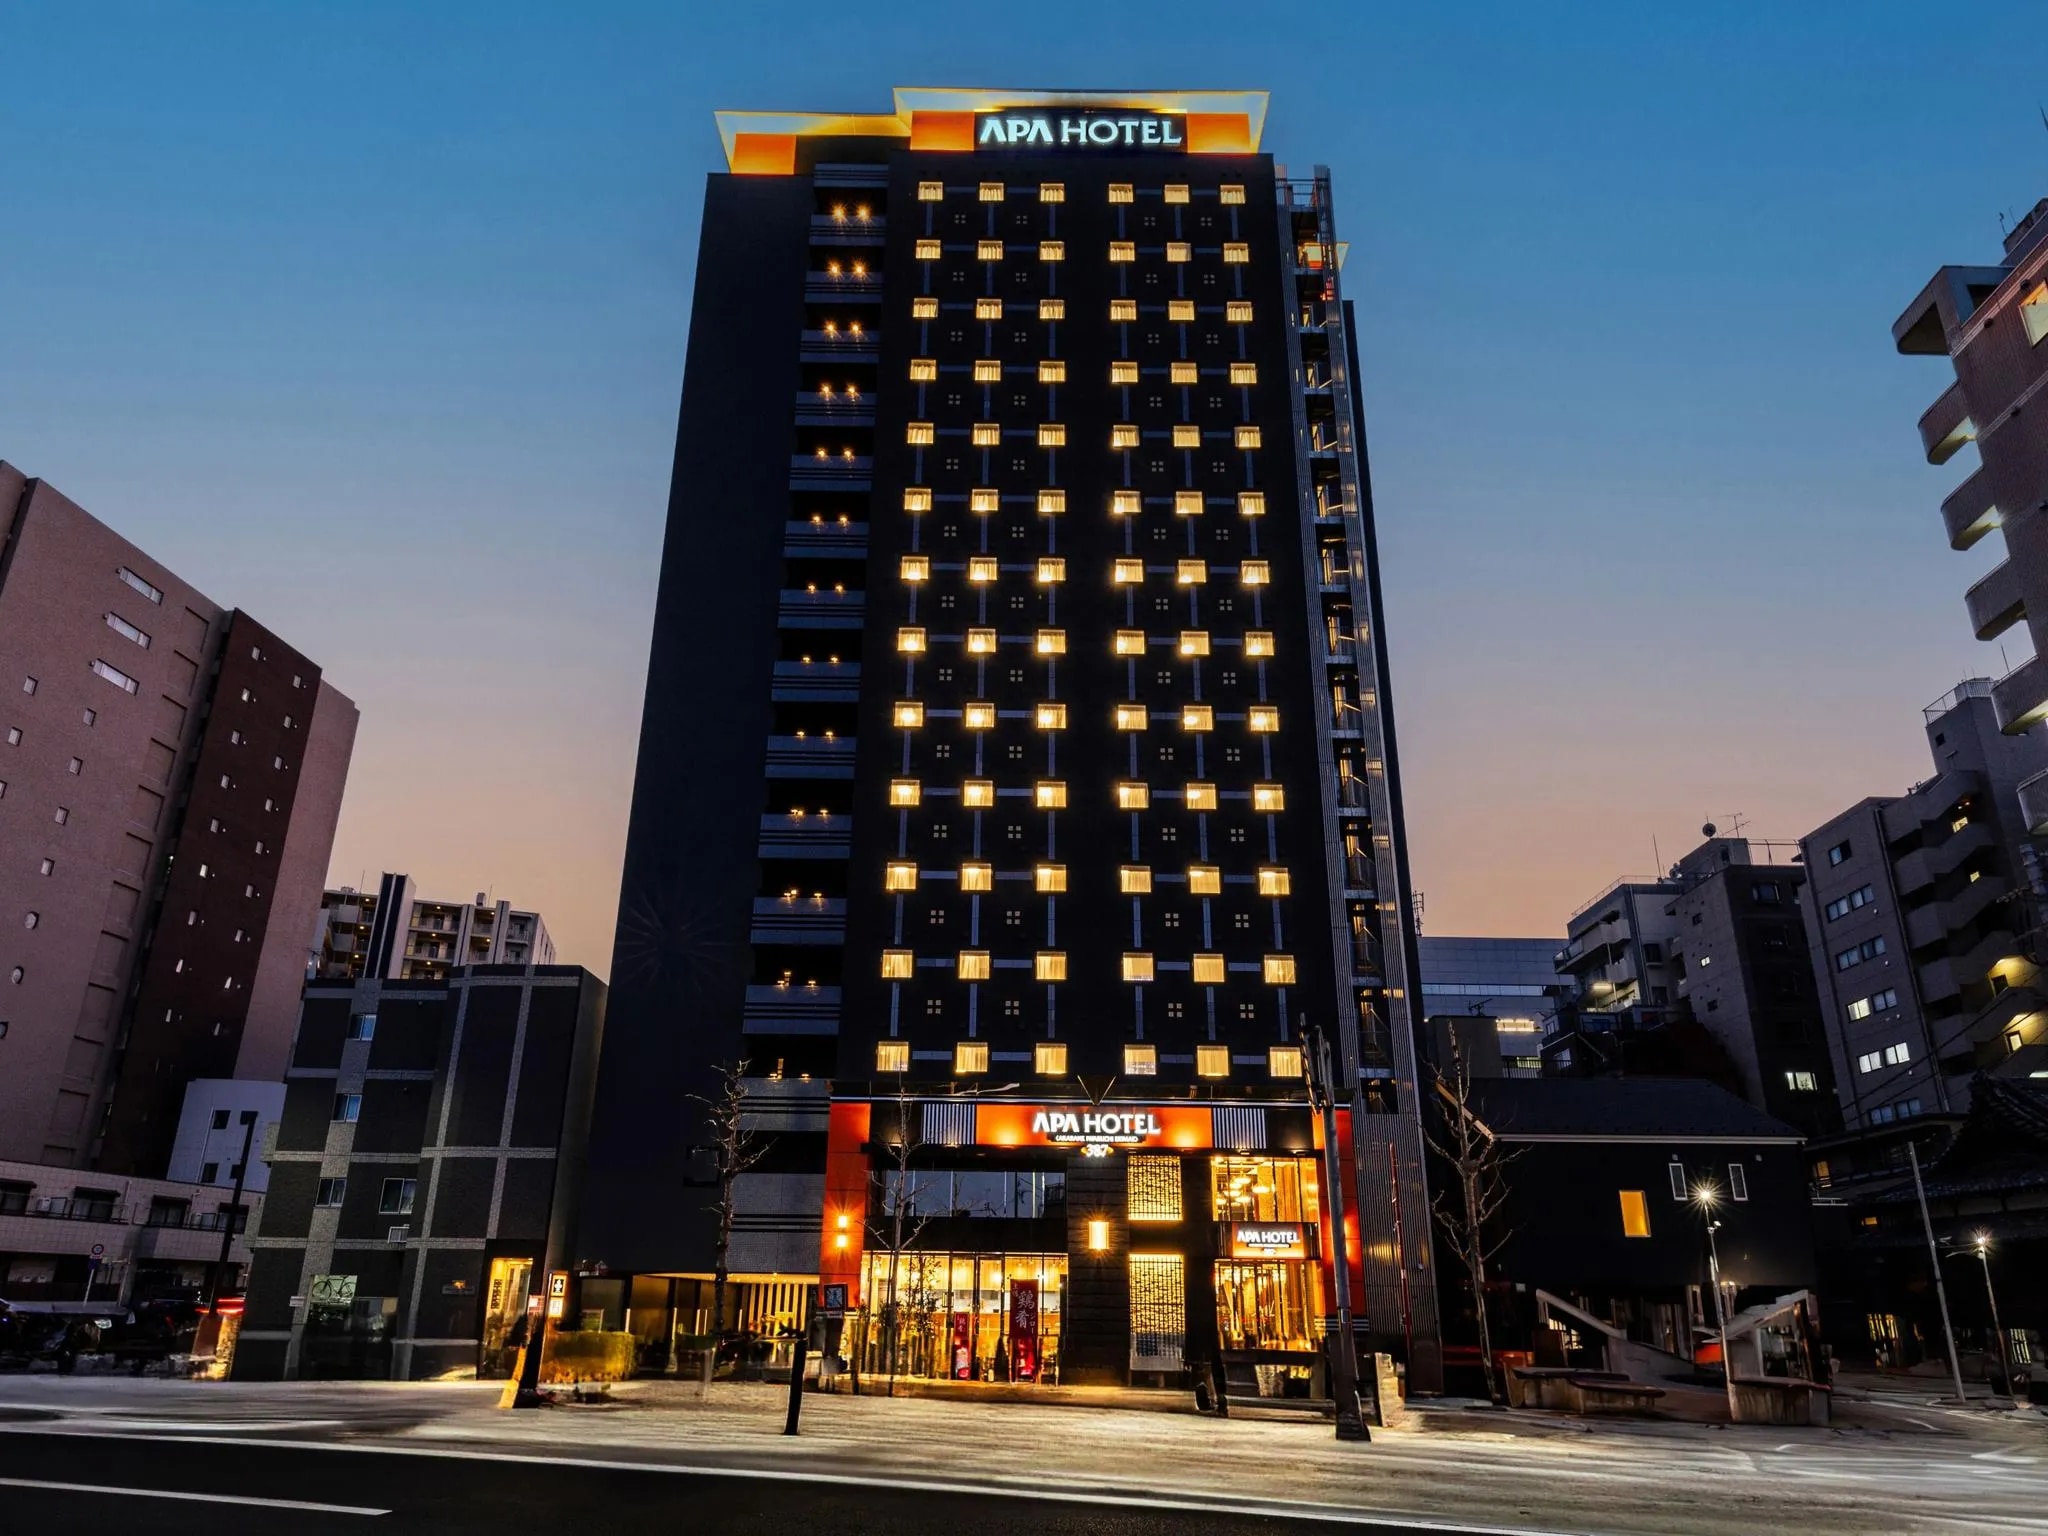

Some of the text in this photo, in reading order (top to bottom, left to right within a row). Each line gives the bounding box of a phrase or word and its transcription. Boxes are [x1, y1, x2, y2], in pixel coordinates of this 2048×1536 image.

[979, 118, 1182, 144] APA HOTEL
[1032, 1112, 1161, 1135] APA HOTEL
[1236, 1230, 1301, 1244] APA HOTEL
